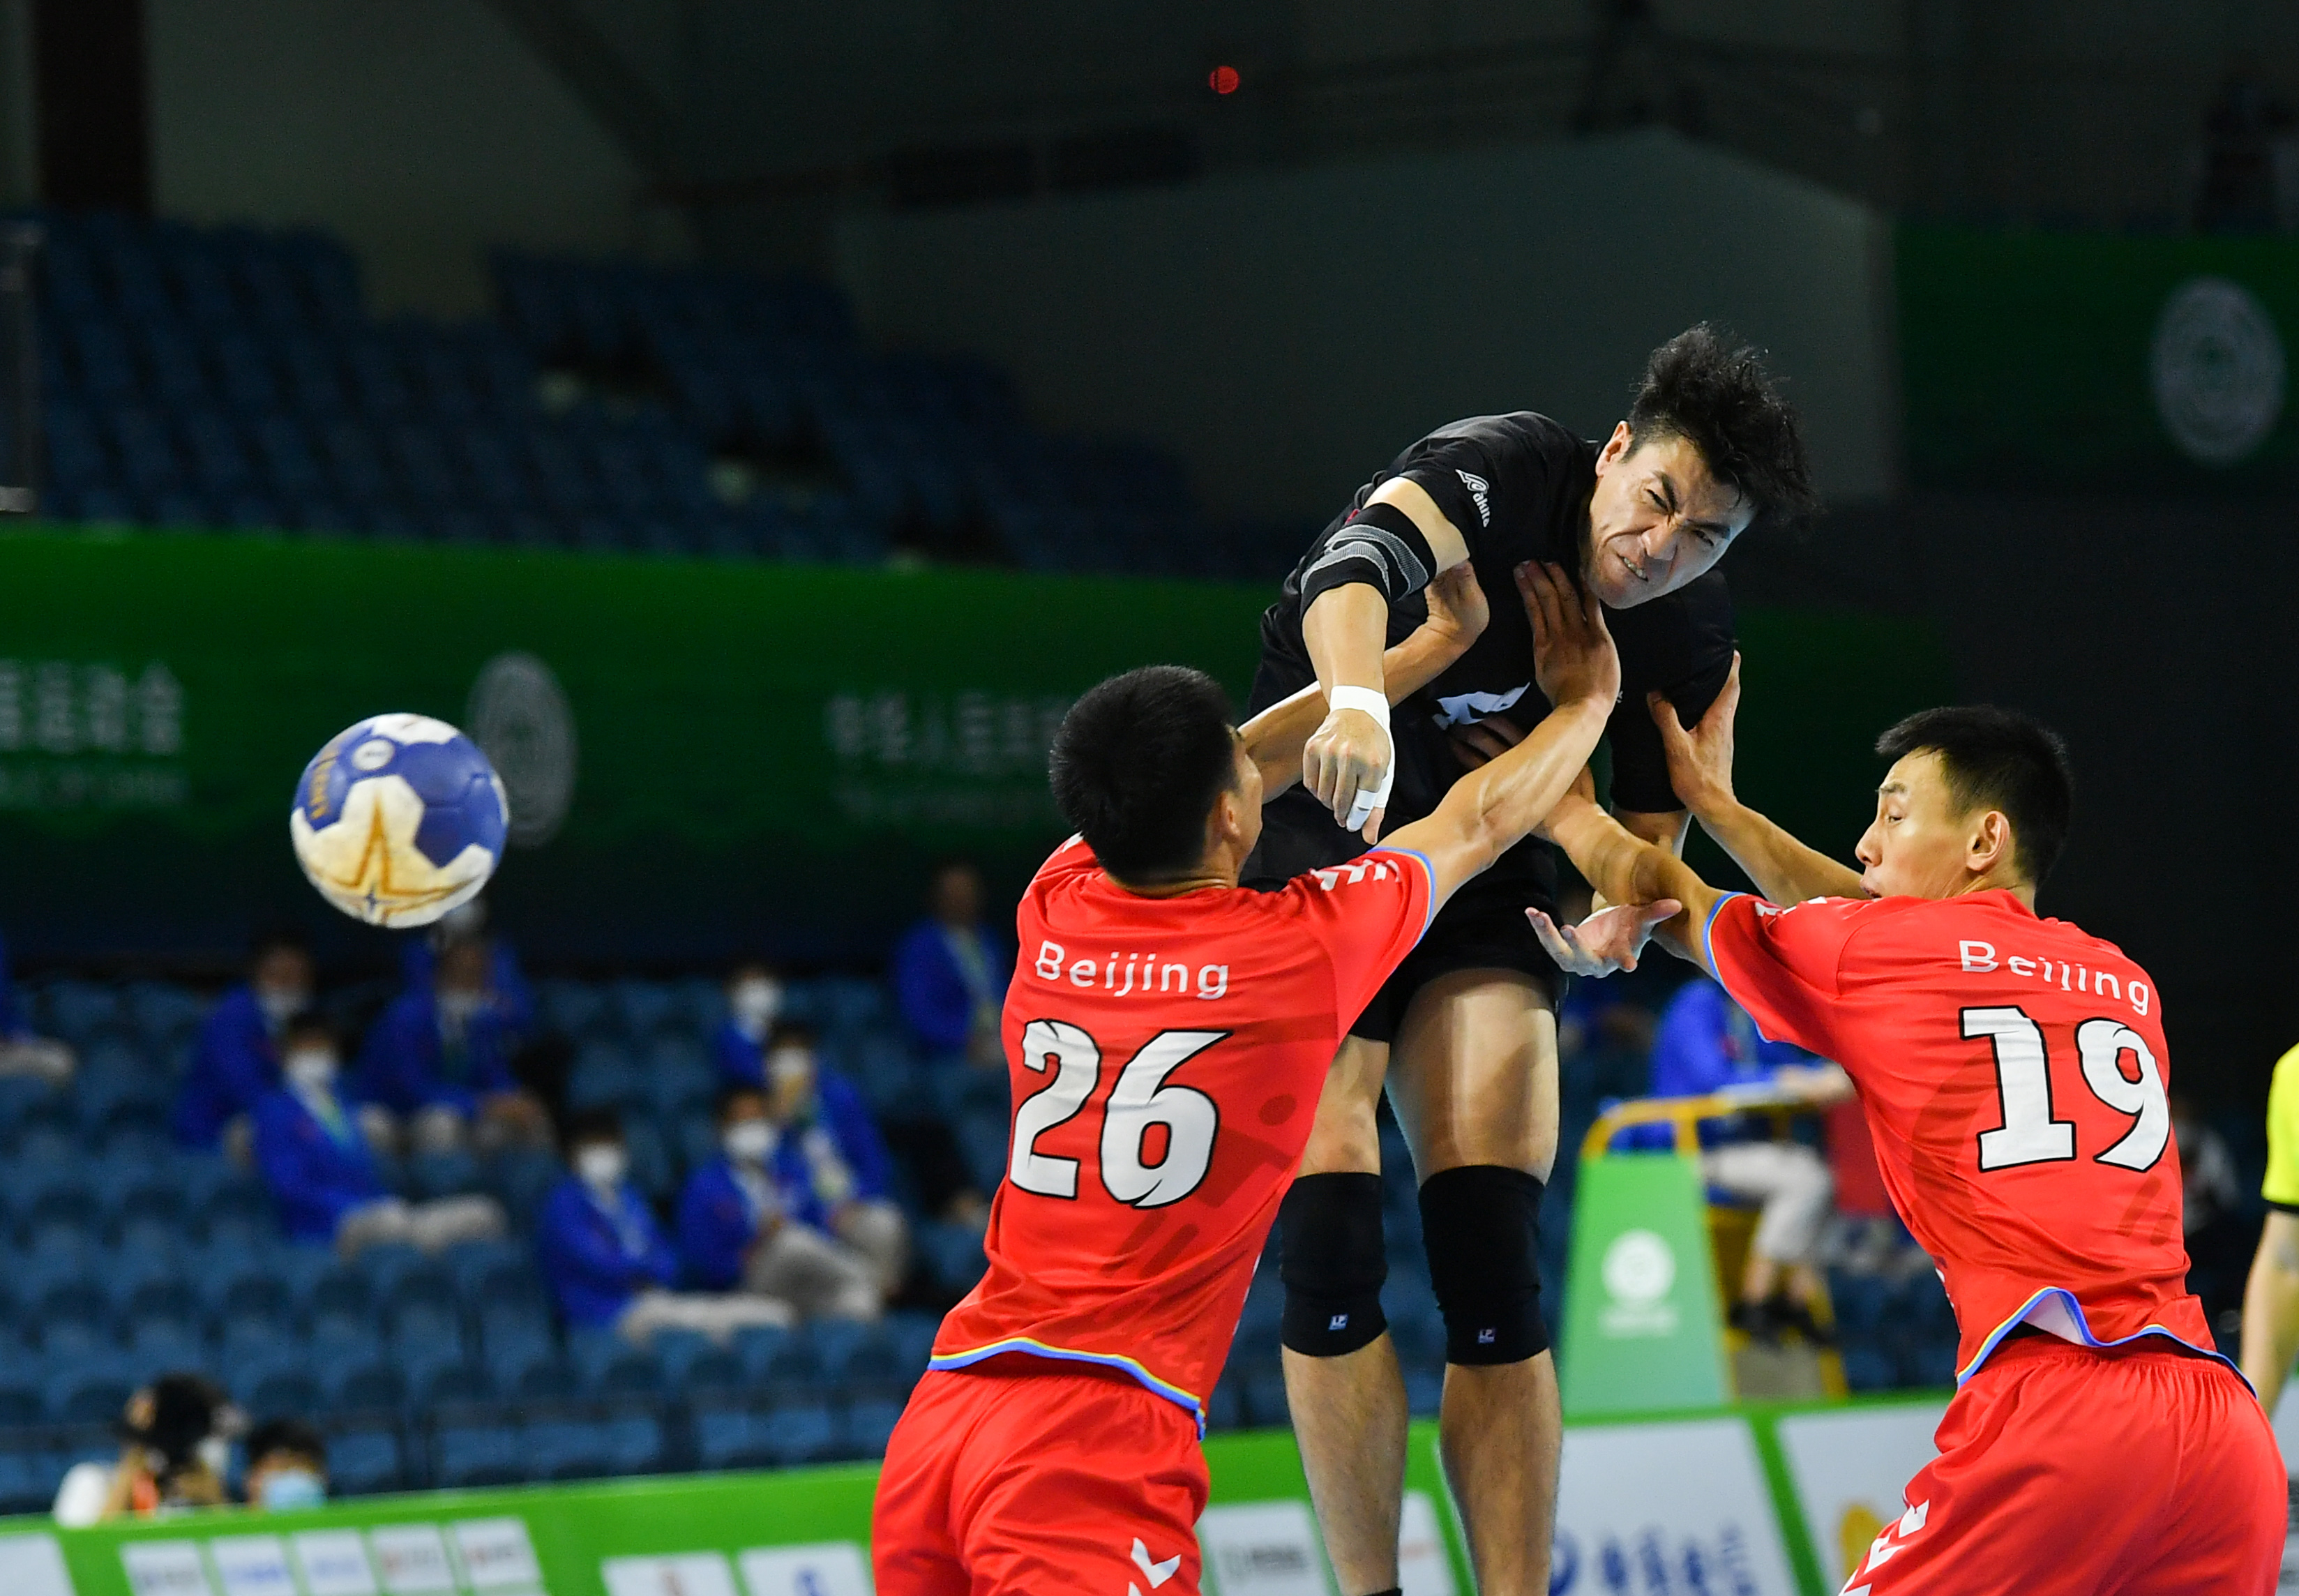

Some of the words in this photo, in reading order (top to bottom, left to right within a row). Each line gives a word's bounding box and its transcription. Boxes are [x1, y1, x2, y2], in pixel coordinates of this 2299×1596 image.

[1035, 940, 1229, 1000] Beijing
[1959, 940, 2149, 1016] Beijing
[1009, 1018, 1233, 1209] 26
[1959, 1005, 2171, 1173] 19
